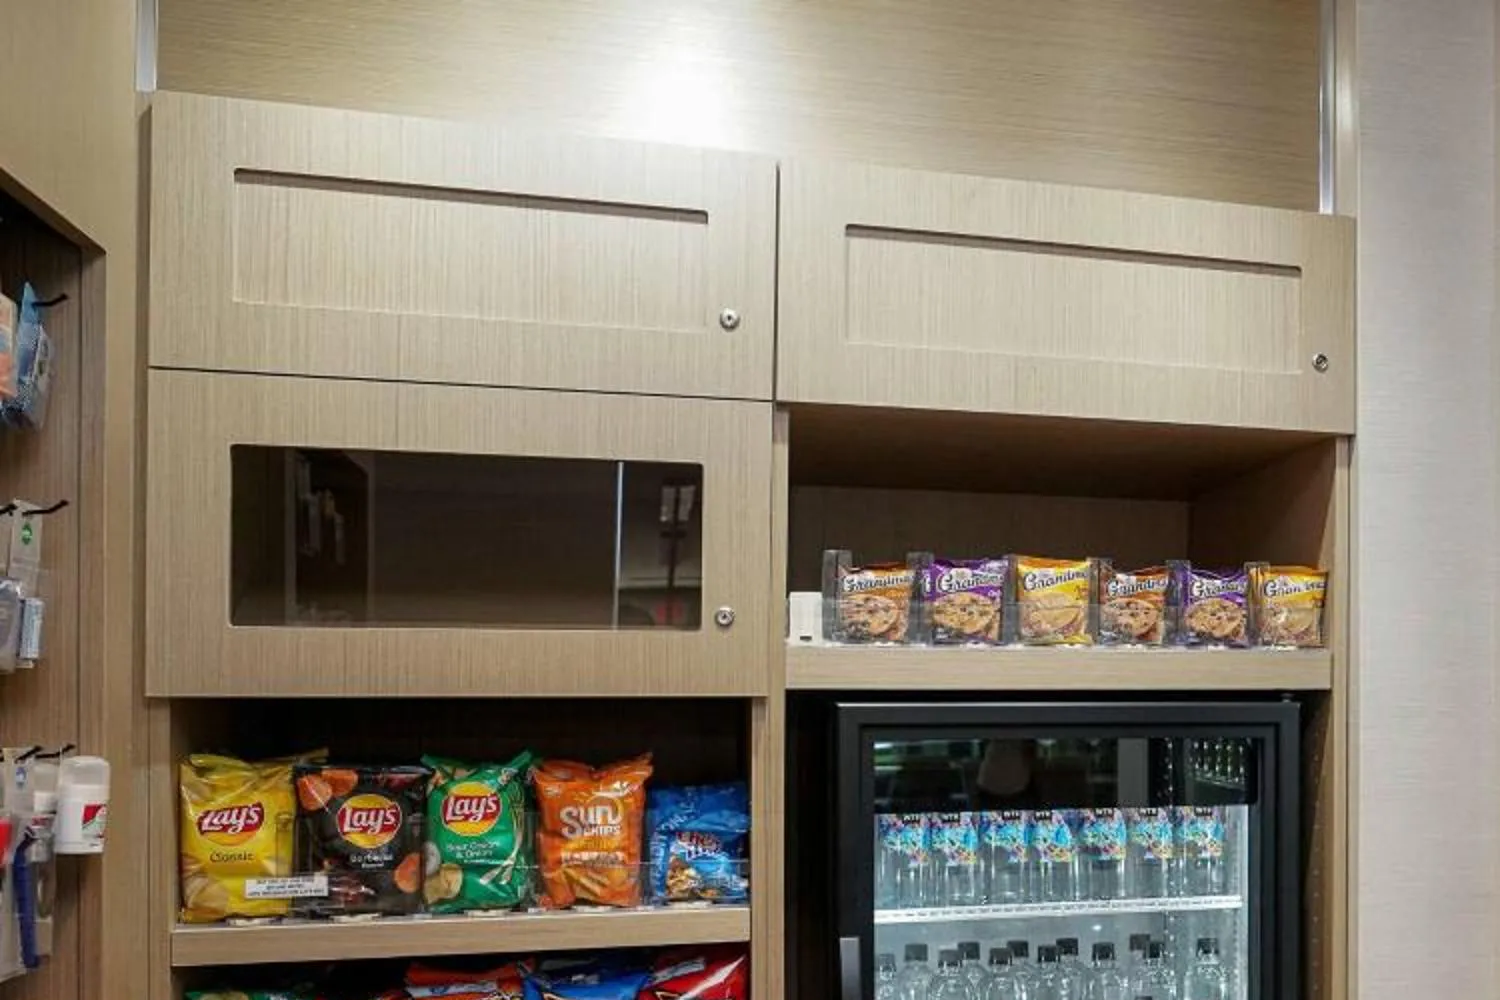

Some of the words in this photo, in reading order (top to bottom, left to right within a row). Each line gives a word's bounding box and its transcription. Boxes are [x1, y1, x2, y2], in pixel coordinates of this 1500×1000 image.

[200, 804, 262, 835] Lay's
[343, 804, 398, 834] Lay's
[446, 792, 498, 822] Lay's
